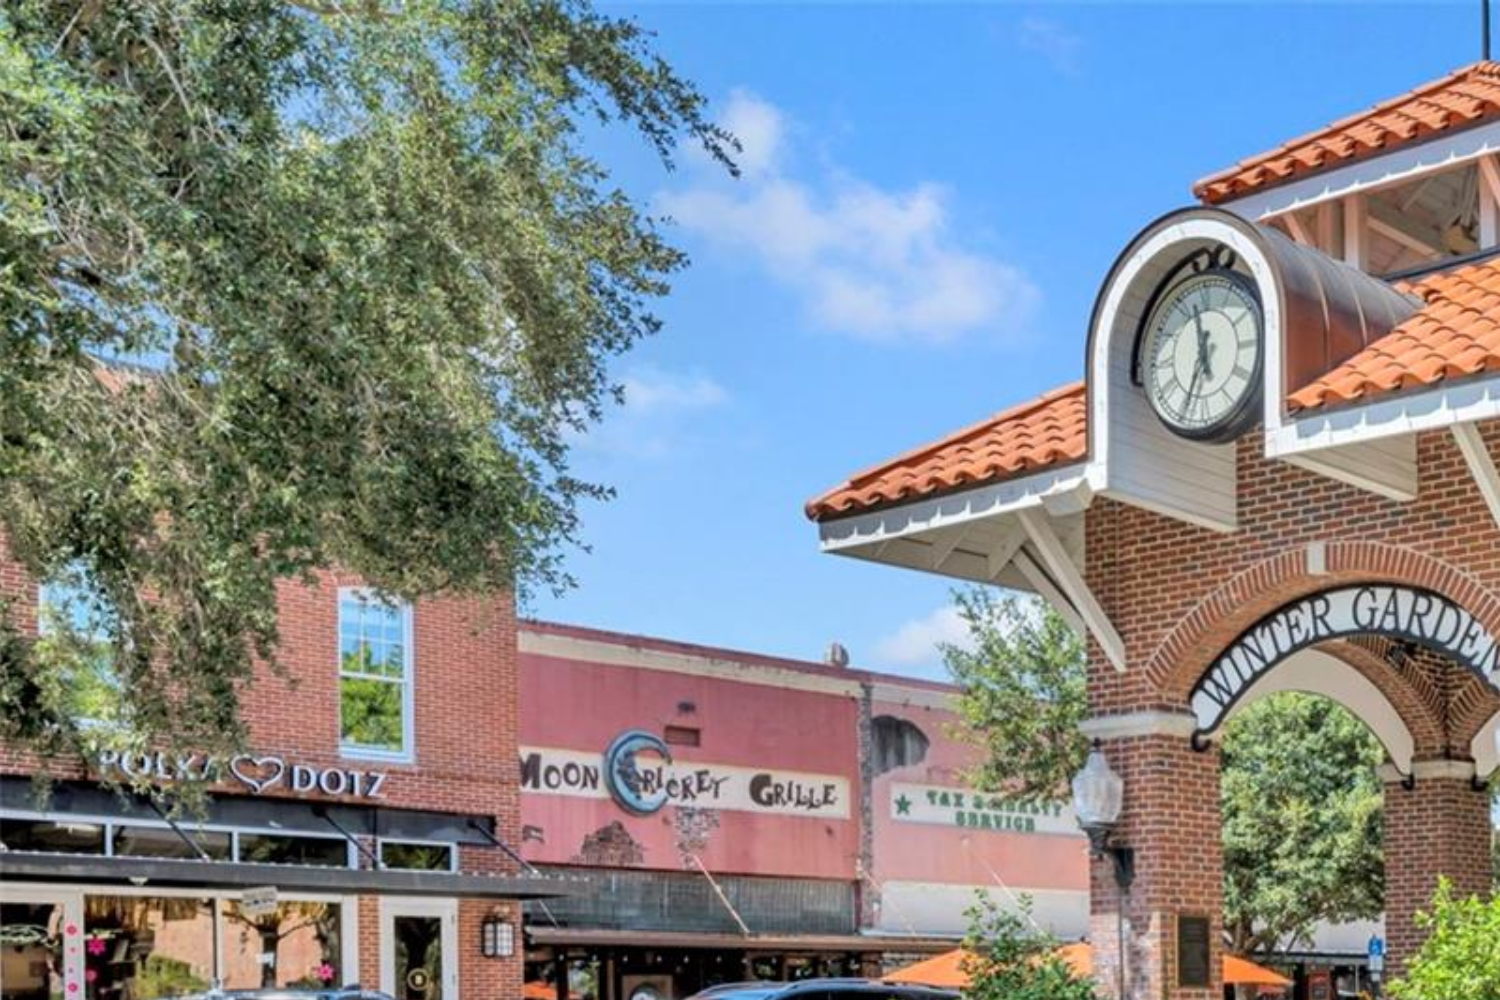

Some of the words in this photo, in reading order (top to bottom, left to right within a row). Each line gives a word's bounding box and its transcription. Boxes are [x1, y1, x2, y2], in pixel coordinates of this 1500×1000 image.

[1201, 595, 1337, 705] WINTER
[1351, 586, 1500, 671] GARDEN
[291, 764, 388, 798] DOTZ
[518, 752, 599, 791] MOON
[749, 773, 837, 809] GRILLE
[926, 790, 965, 808] TAX
[955, 810, 1036, 833] SERVICE
